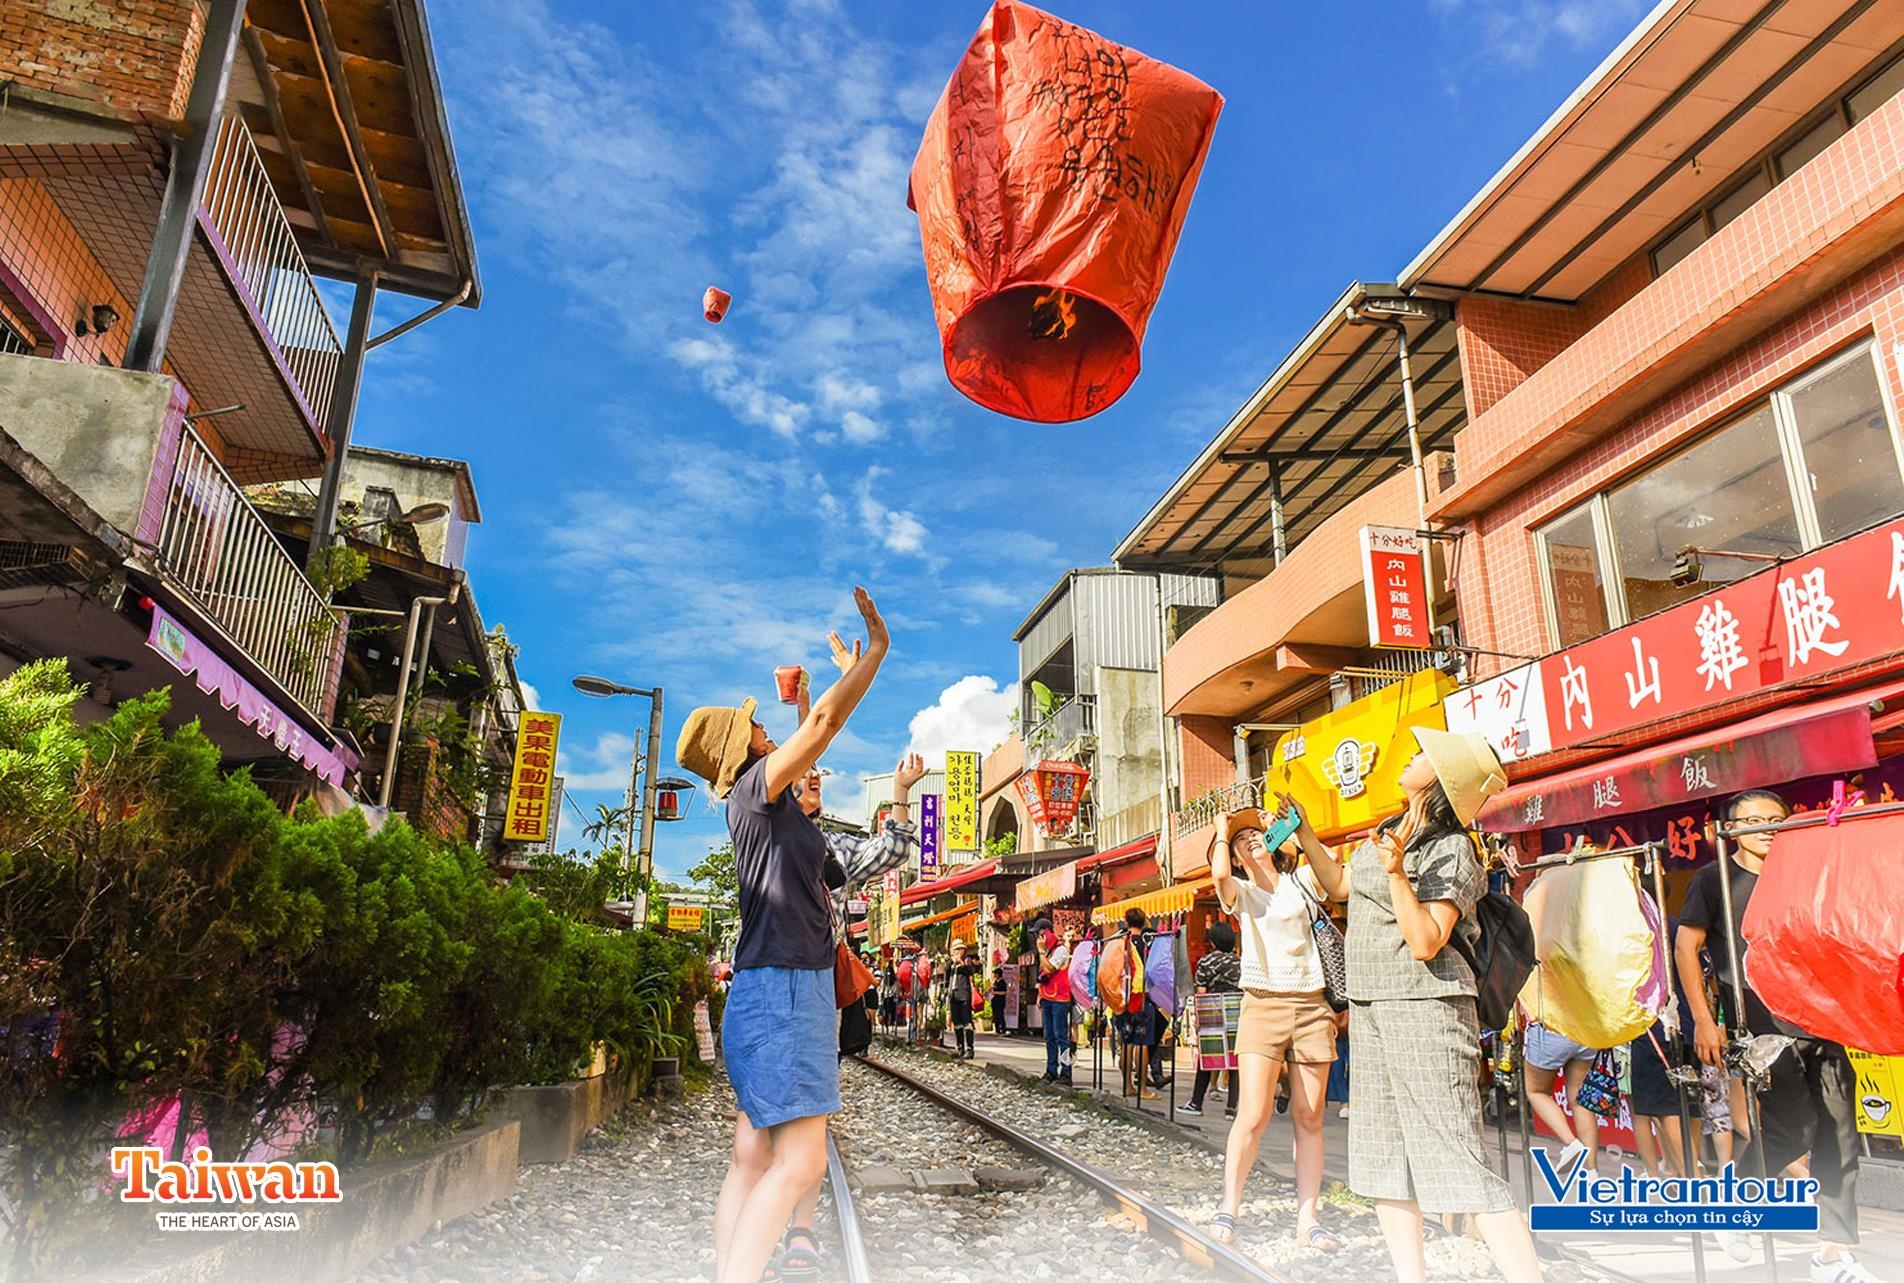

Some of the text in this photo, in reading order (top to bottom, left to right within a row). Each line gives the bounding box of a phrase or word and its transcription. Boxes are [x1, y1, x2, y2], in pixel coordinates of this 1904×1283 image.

[1369, 531, 1417, 550] 十分好吃
[1386, 558, 1414, 637] 內山雞腿飯
[511, 718, 554, 836] 美果電動車出租
[1523, 757, 1717, 825] 雞腿飯
